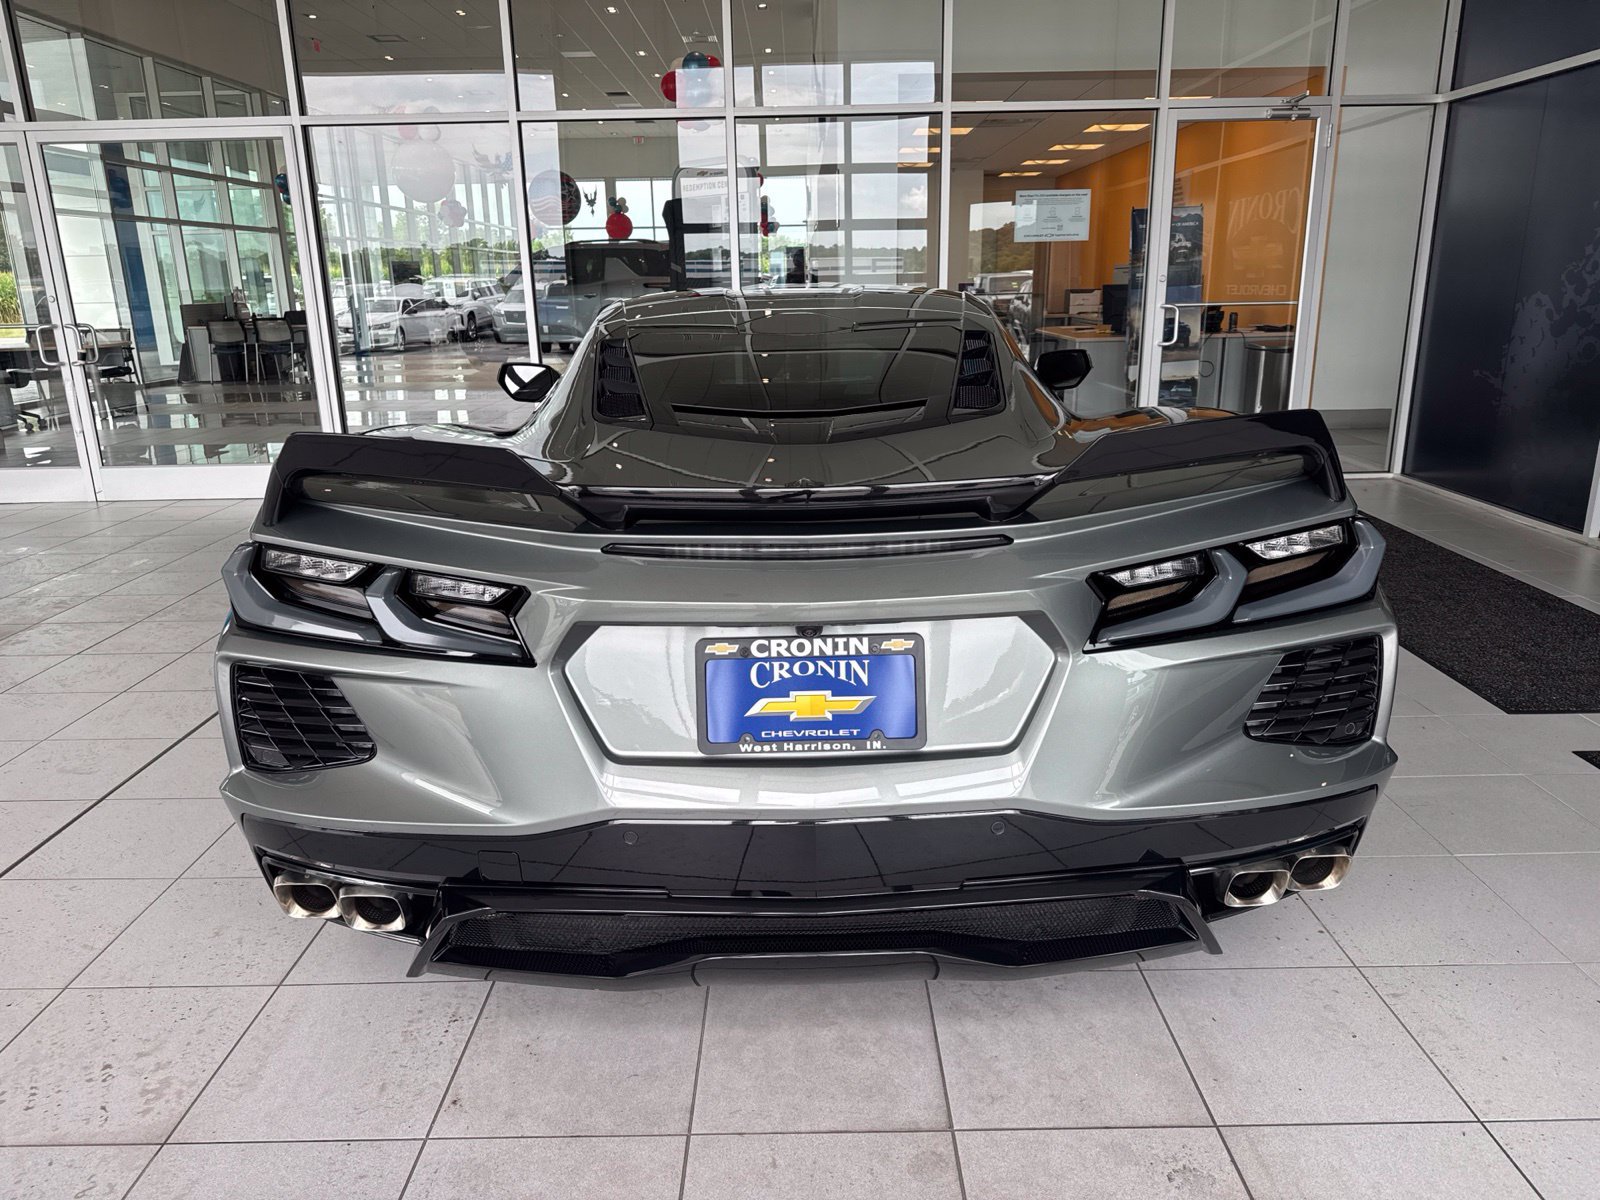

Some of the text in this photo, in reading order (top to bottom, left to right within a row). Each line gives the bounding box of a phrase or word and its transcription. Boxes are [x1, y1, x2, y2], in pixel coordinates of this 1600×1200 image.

[750, 637, 869, 658] CRONIN
[750, 659, 870, 688] CRONIN
[761, 729, 861, 738] CHEVROLET
[739, 740, 886, 753] West Harrison, IN.
